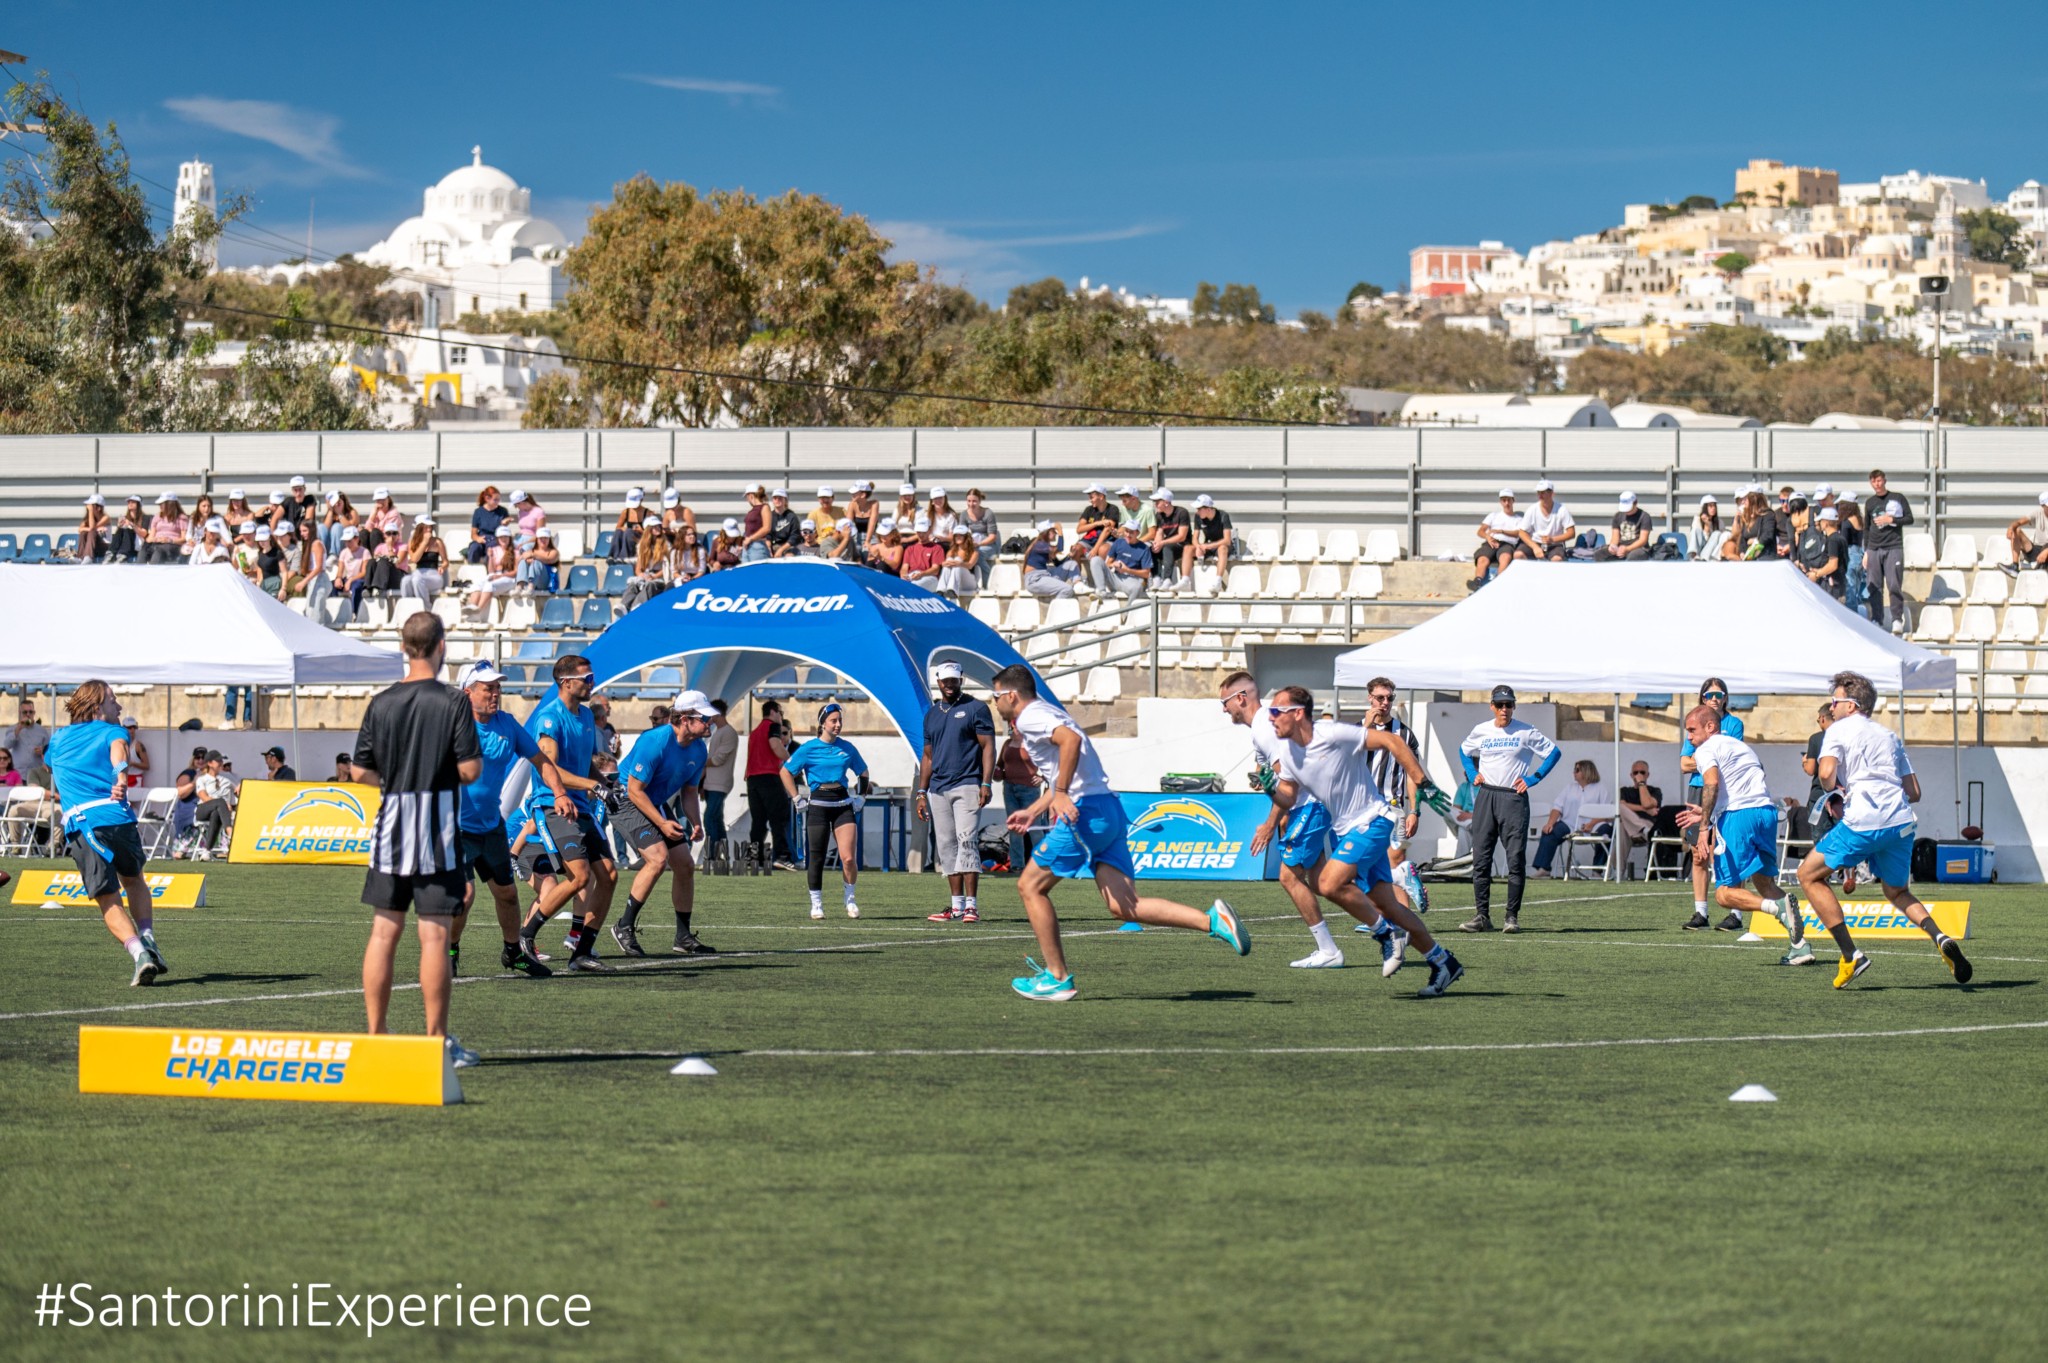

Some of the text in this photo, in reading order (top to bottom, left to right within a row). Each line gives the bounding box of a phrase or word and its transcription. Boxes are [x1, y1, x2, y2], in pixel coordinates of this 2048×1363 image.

[672, 588, 848, 613] Stoiximan
[866, 586, 949, 613] Stoiximan
[1481, 741, 1519, 749] CHARGERS
[260, 825, 372, 839] LOS ANGELE
[255, 838, 371, 856] CHARGERS
[1152, 841, 1243, 853] ANGELES
[1132, 853, 1238, 874] ARGERS
[171, 1036, 353, 1060] LOS ANGELES
[166, 1057, 346, 1090] CHARGERS
